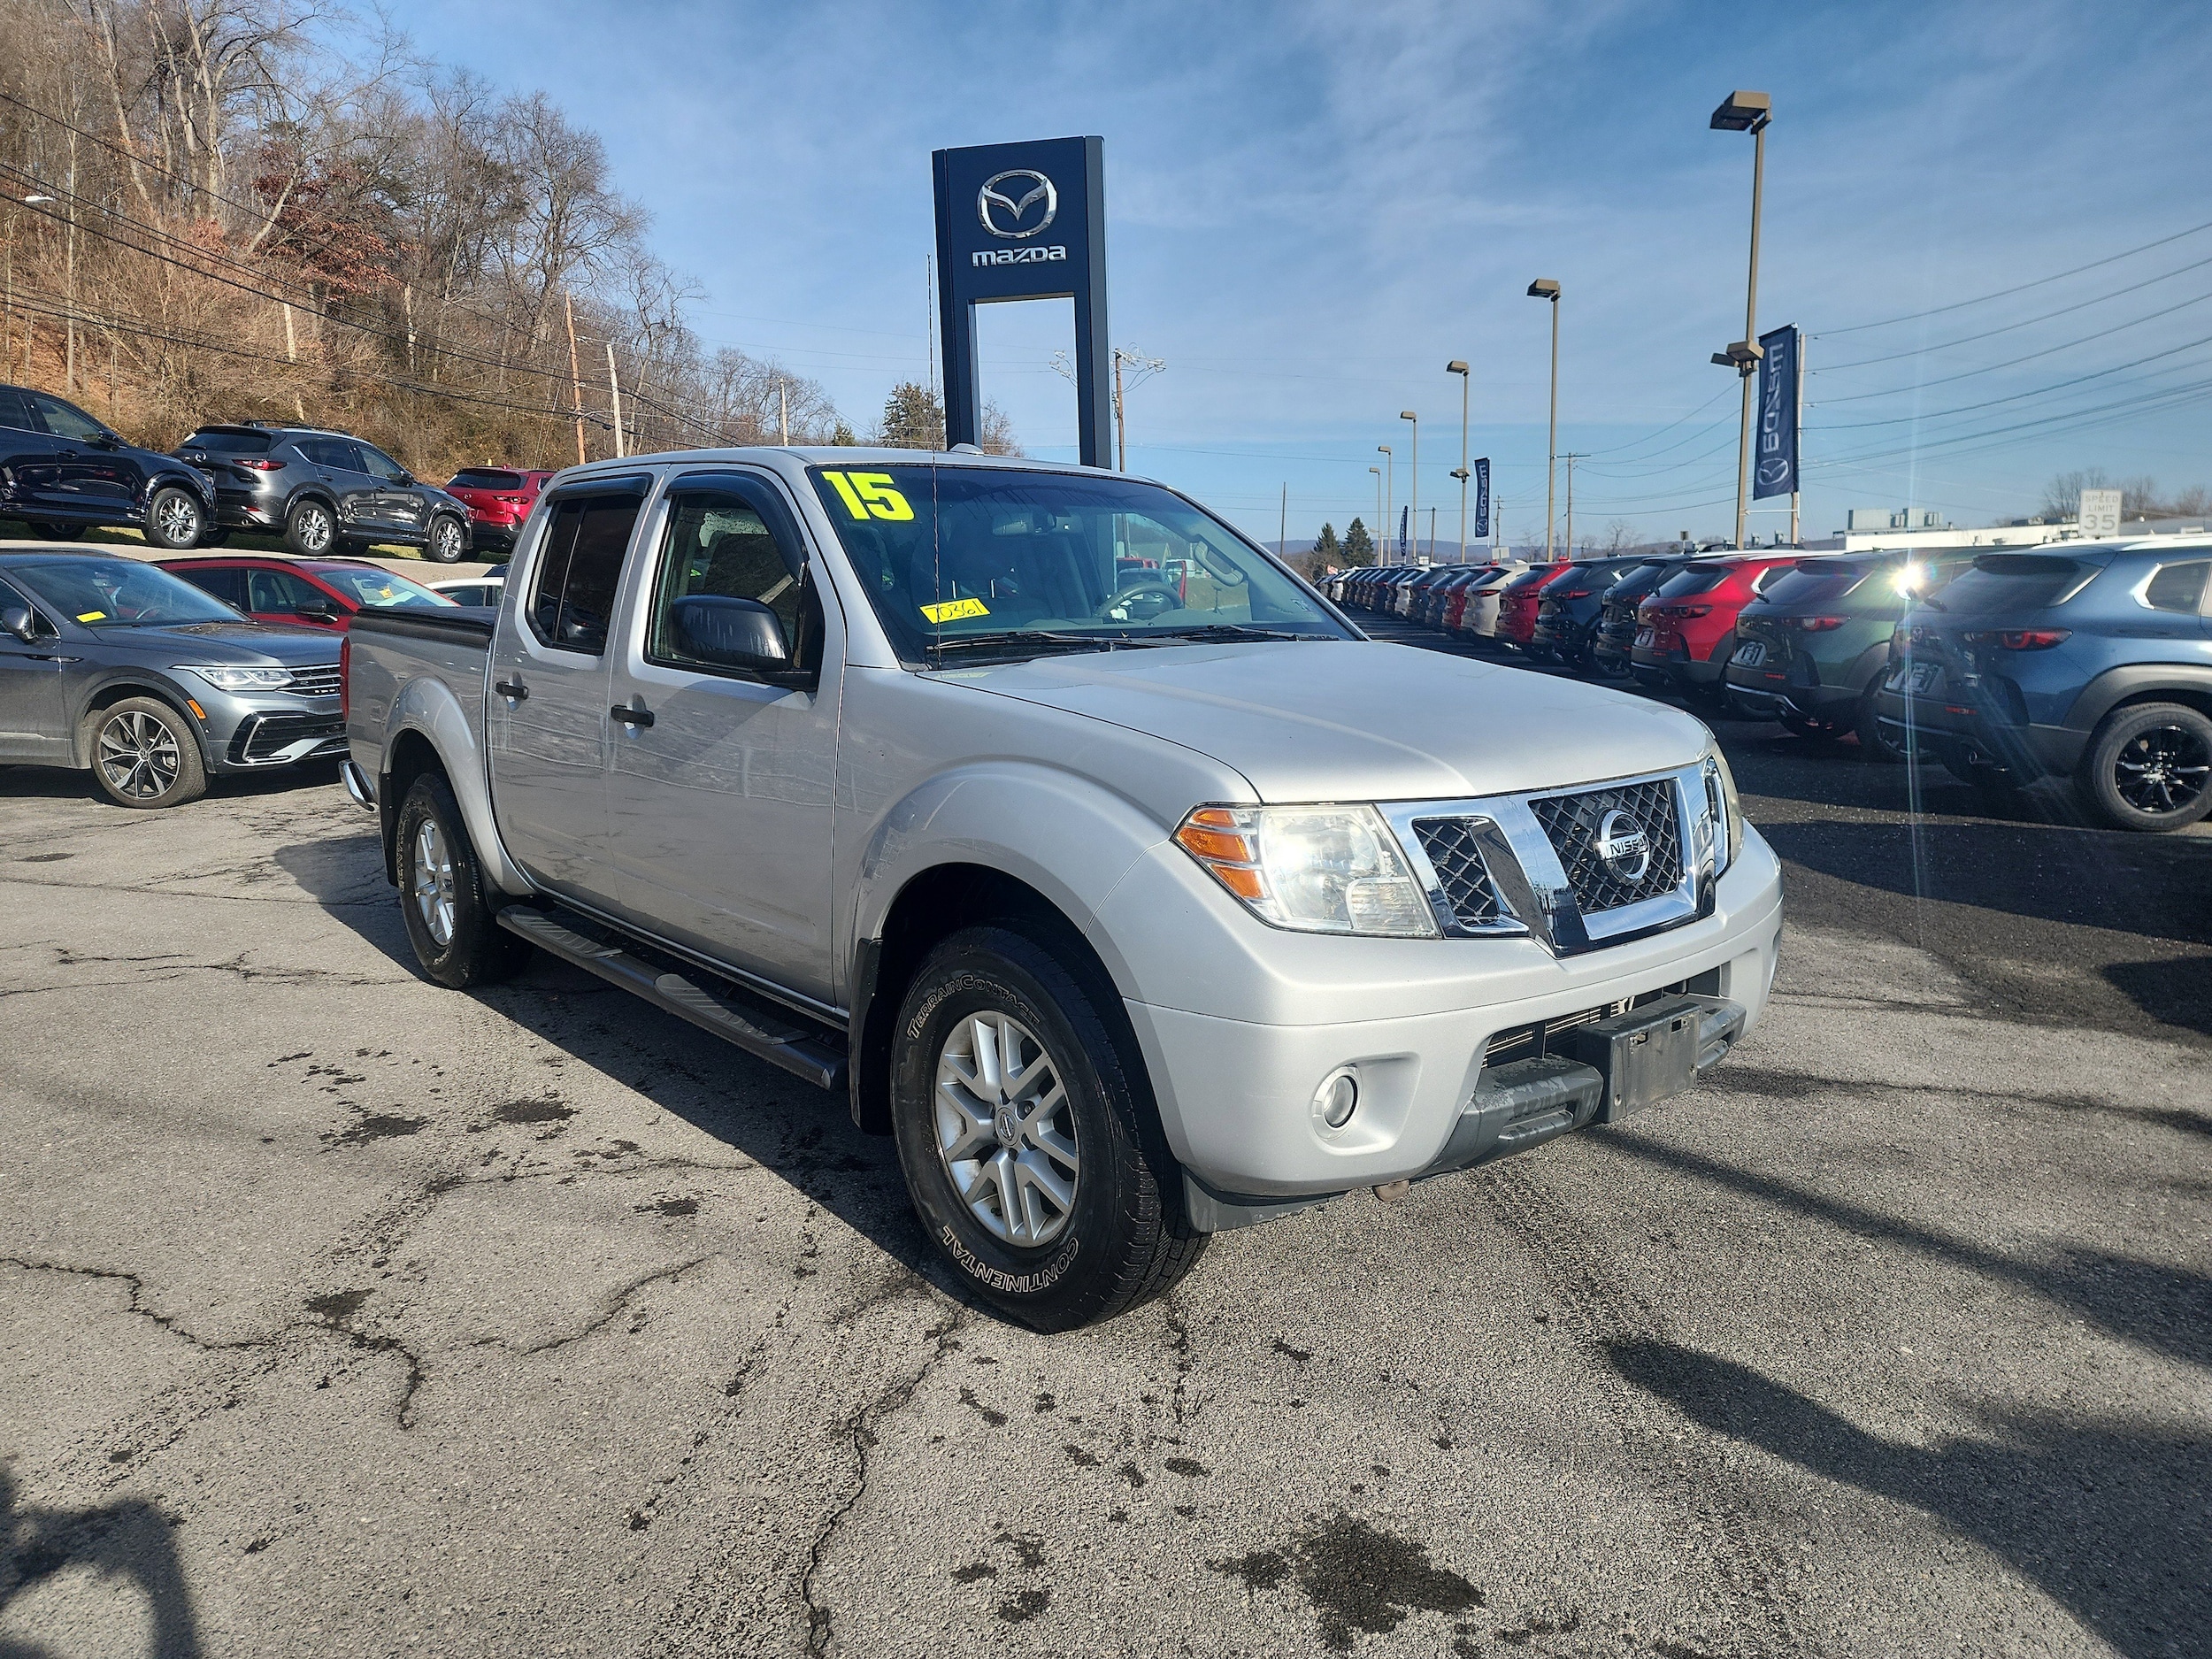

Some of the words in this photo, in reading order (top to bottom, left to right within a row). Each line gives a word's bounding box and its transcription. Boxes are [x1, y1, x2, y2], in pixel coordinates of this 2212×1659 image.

[820, 471, 915, 520] 15
[2084, 514, 2116, 530] 35
[925, 600, 983, 620] 70361
[942, 1225, 1079, 1294] CONTINENTAL
